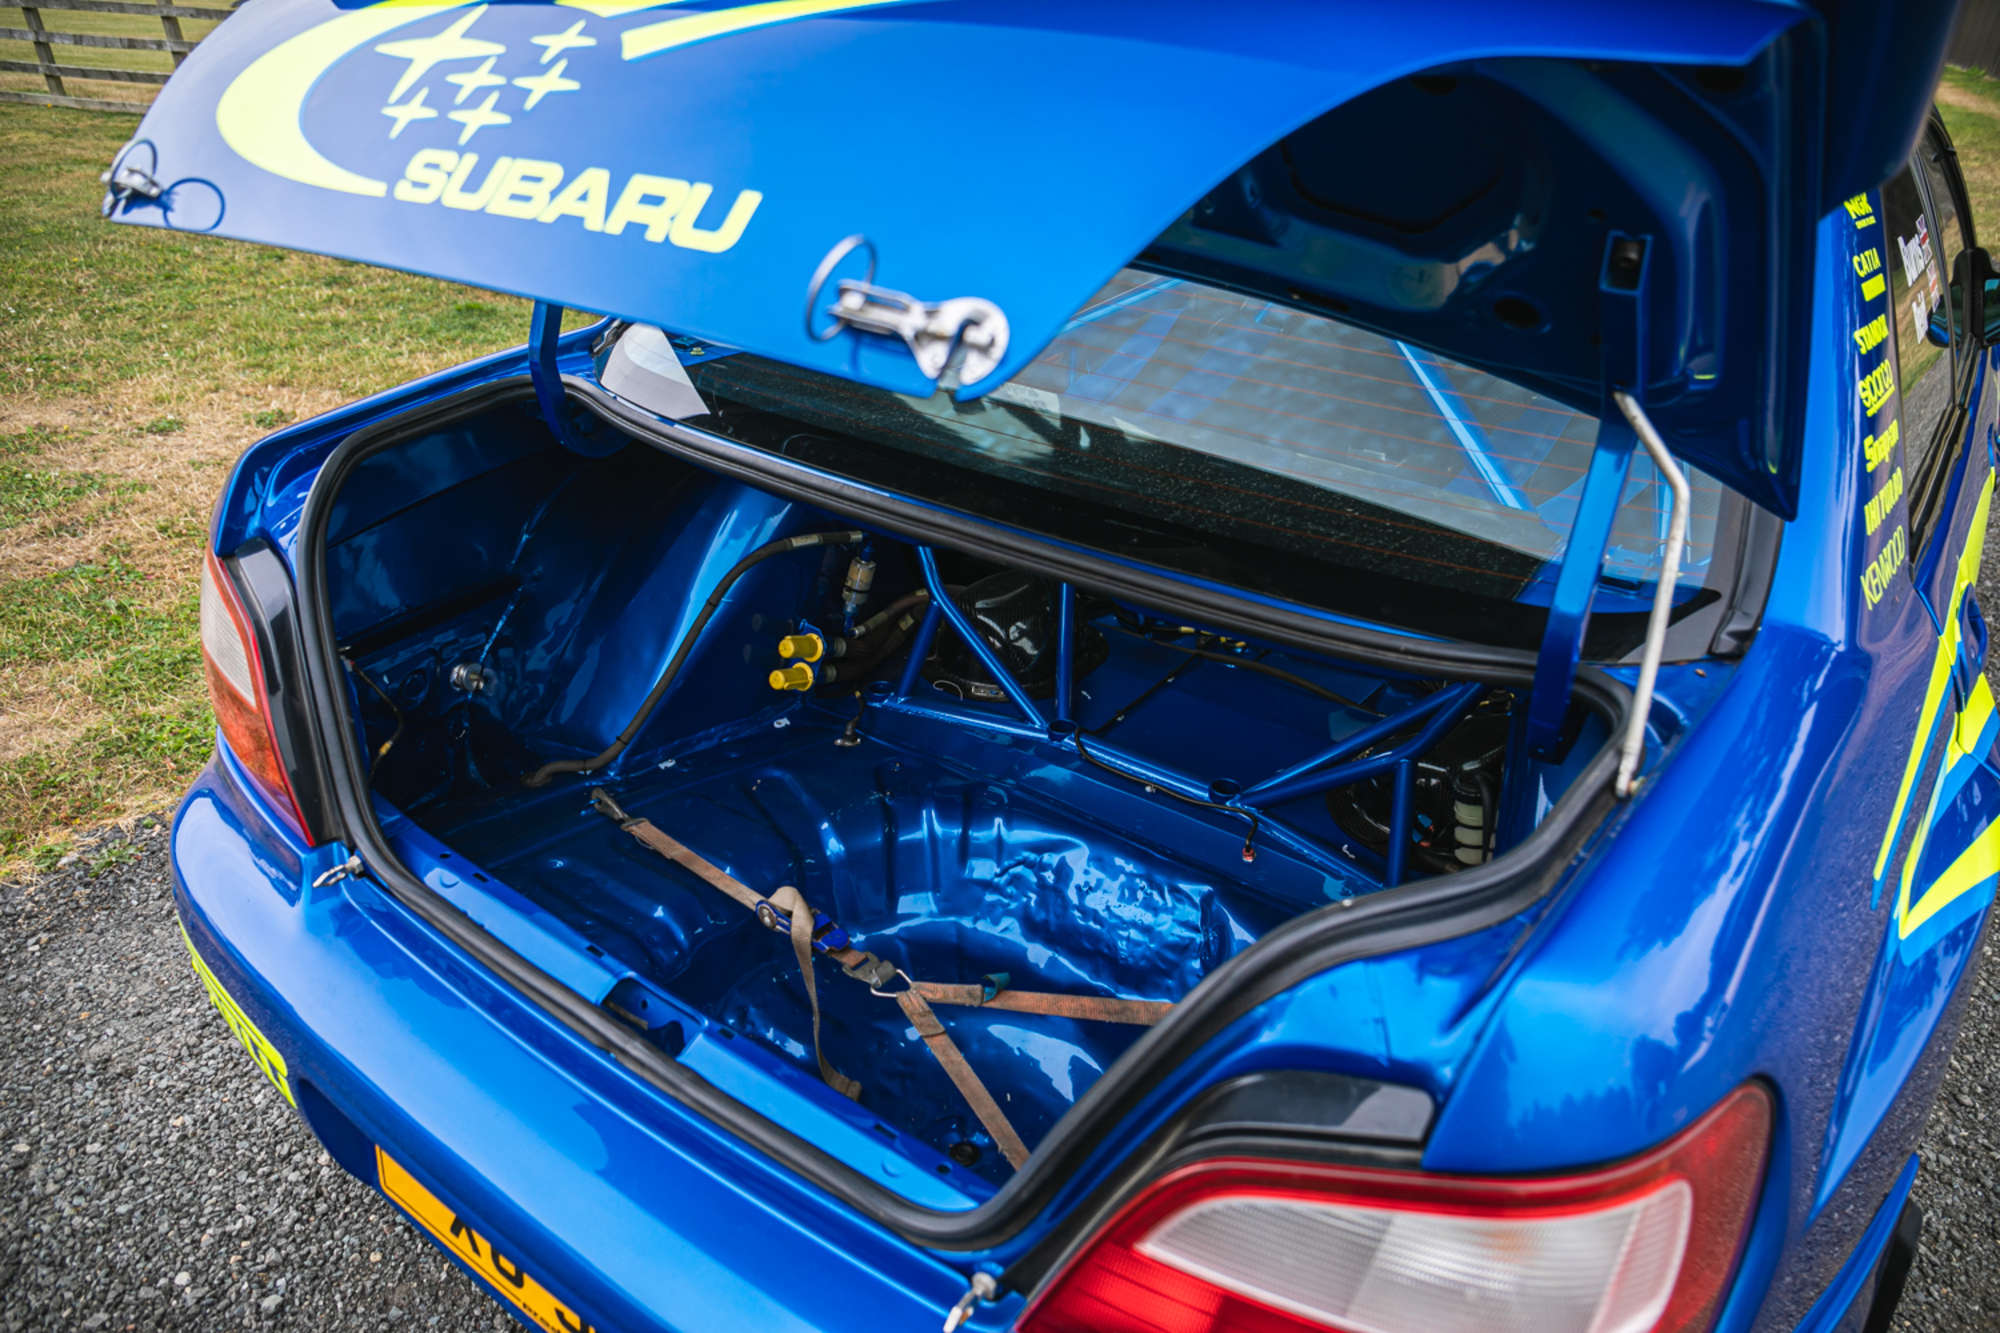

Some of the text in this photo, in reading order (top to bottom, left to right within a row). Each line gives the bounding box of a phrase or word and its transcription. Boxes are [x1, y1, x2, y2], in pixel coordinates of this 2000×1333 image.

[394, 148, 763, 253] SUBARU
[1843, 192, 1873, 219] NGK
[1860, 525, 1906, 611] KENWOOD
